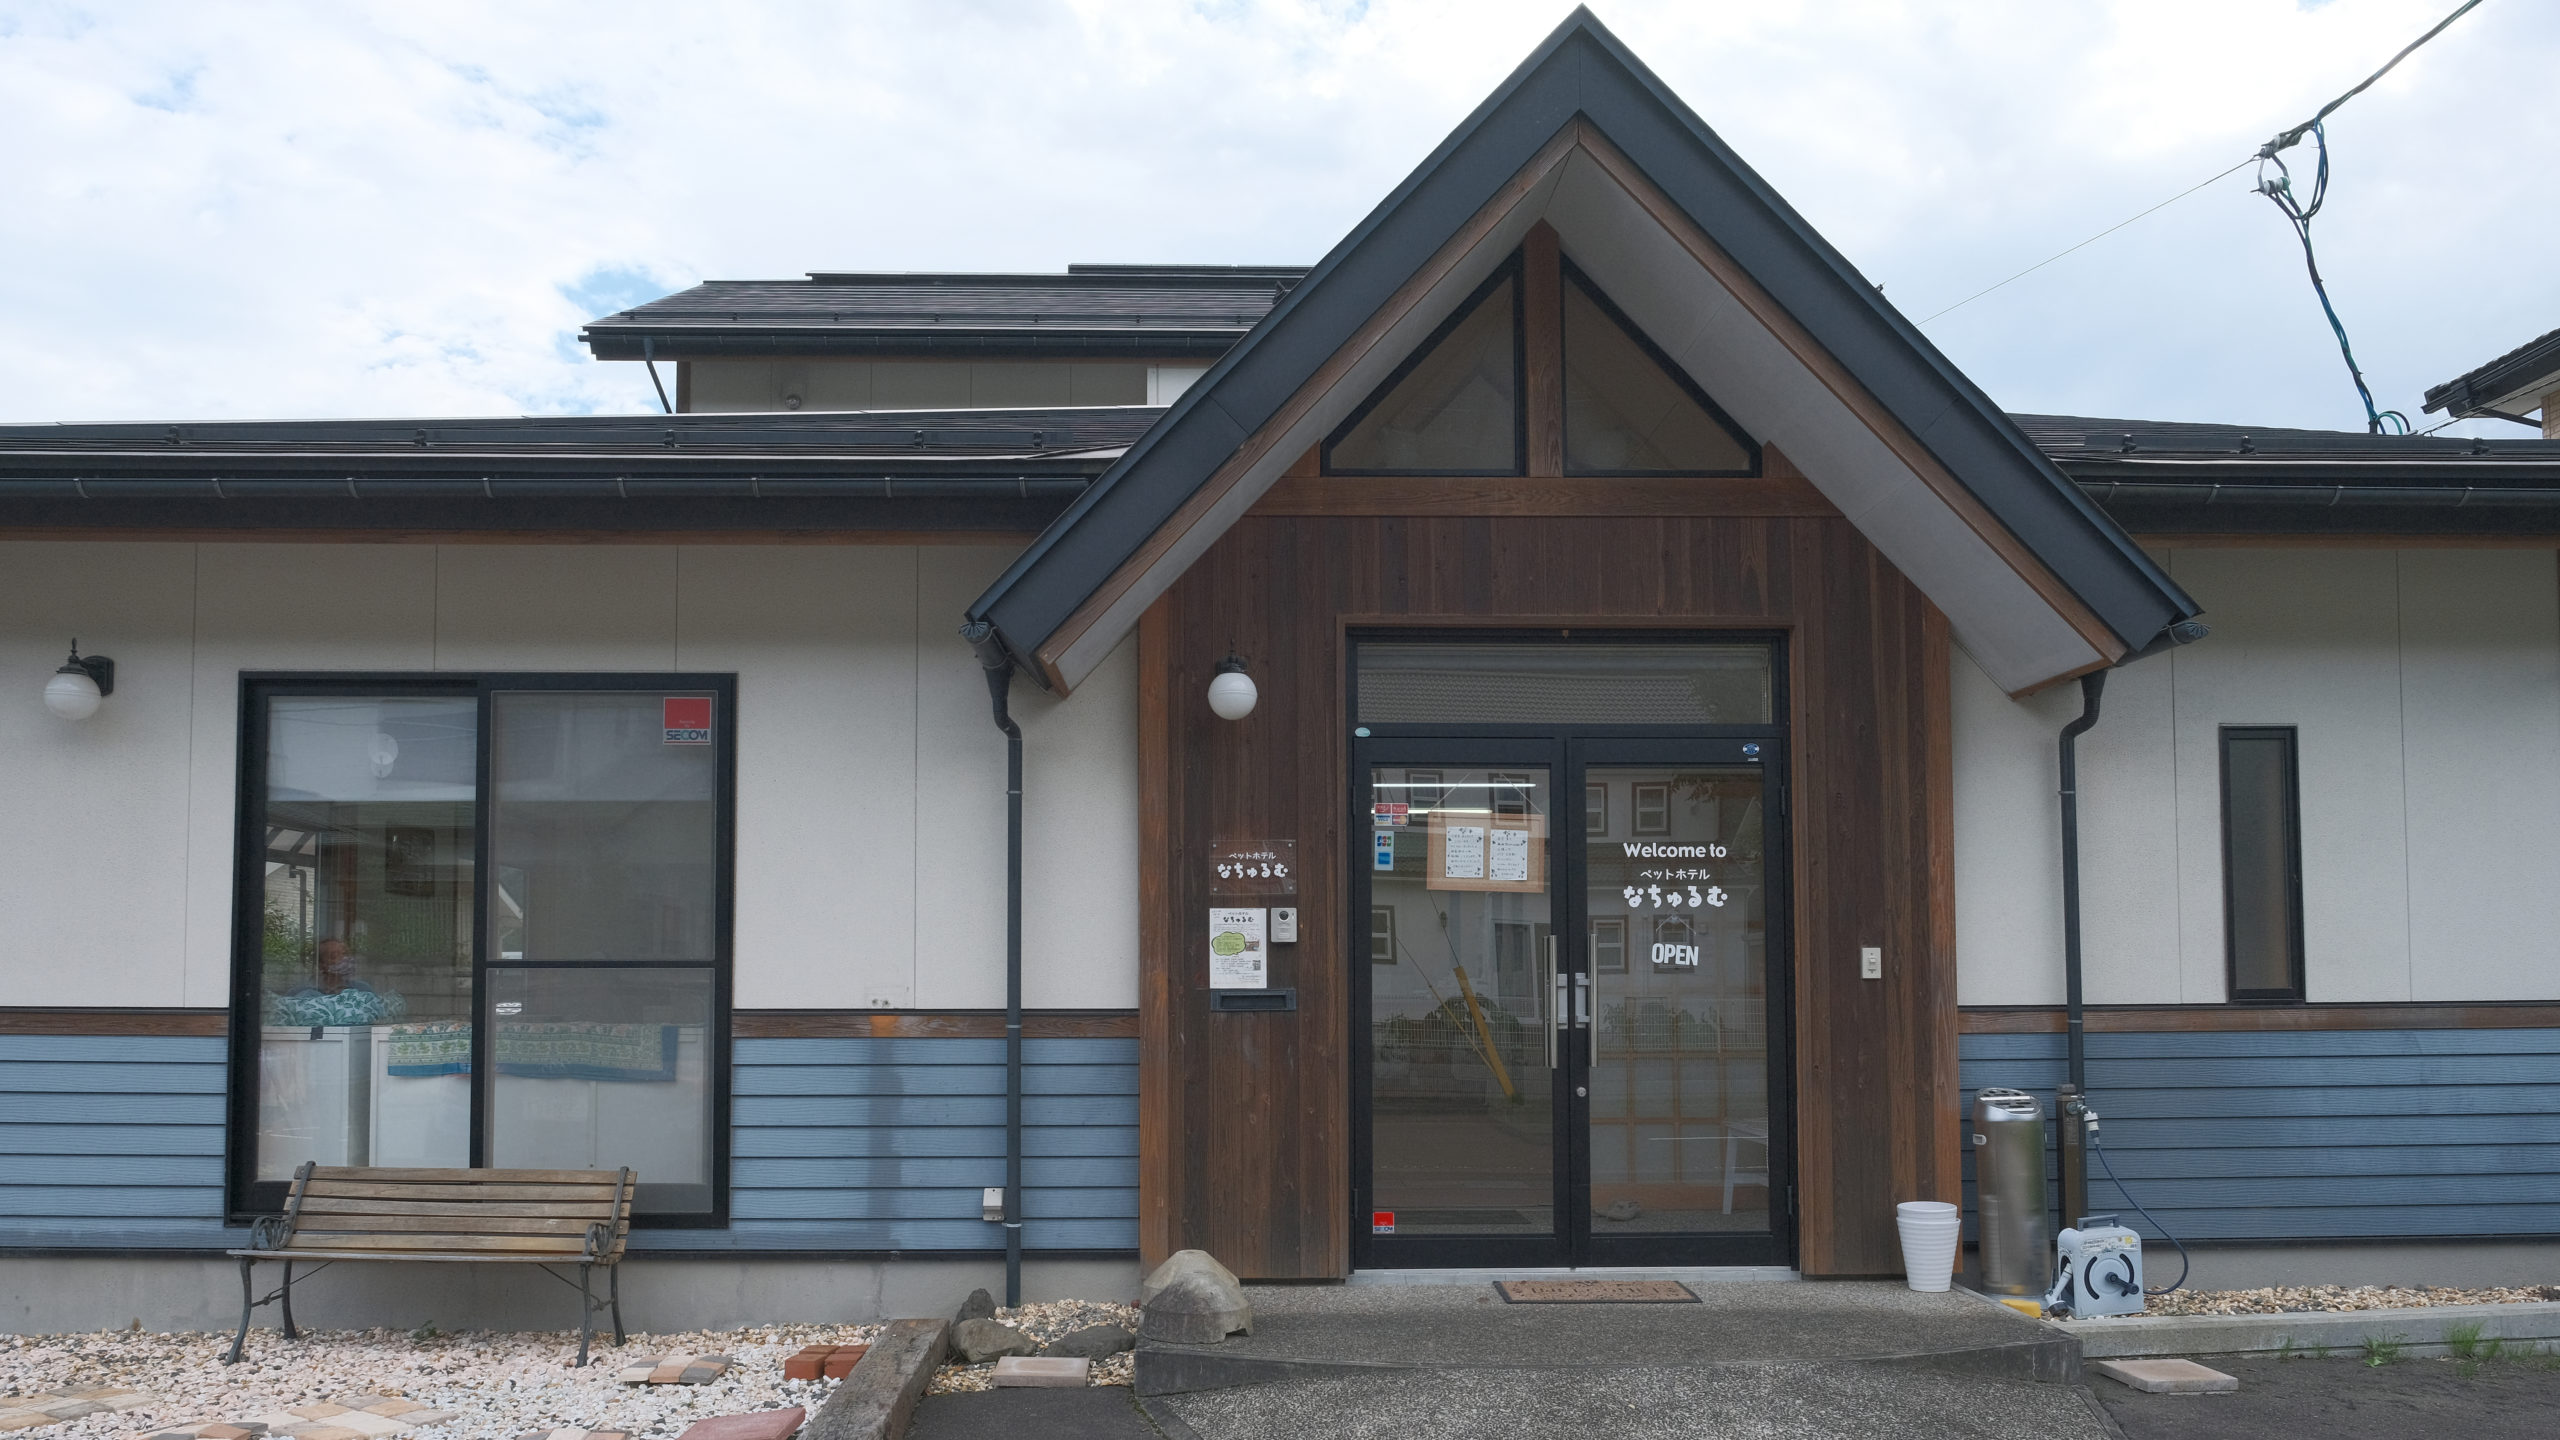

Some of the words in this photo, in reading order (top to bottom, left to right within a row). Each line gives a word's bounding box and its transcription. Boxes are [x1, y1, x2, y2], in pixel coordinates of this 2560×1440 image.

[666, 730, 708, 740] SECOM
[1228, 851, 1277, 860] ペットホテル
[1623, 842, 1706, 858] Welcome
[1709, 843, 1727, 858] to
[1217, 863, 1289, 879] なちゅるむ
[1640, 868, 1710, 881] ペットホテル
[1623, 884, 1728, 908] なちゅるむ
[1651, 943, 1699, 966] OPEN
